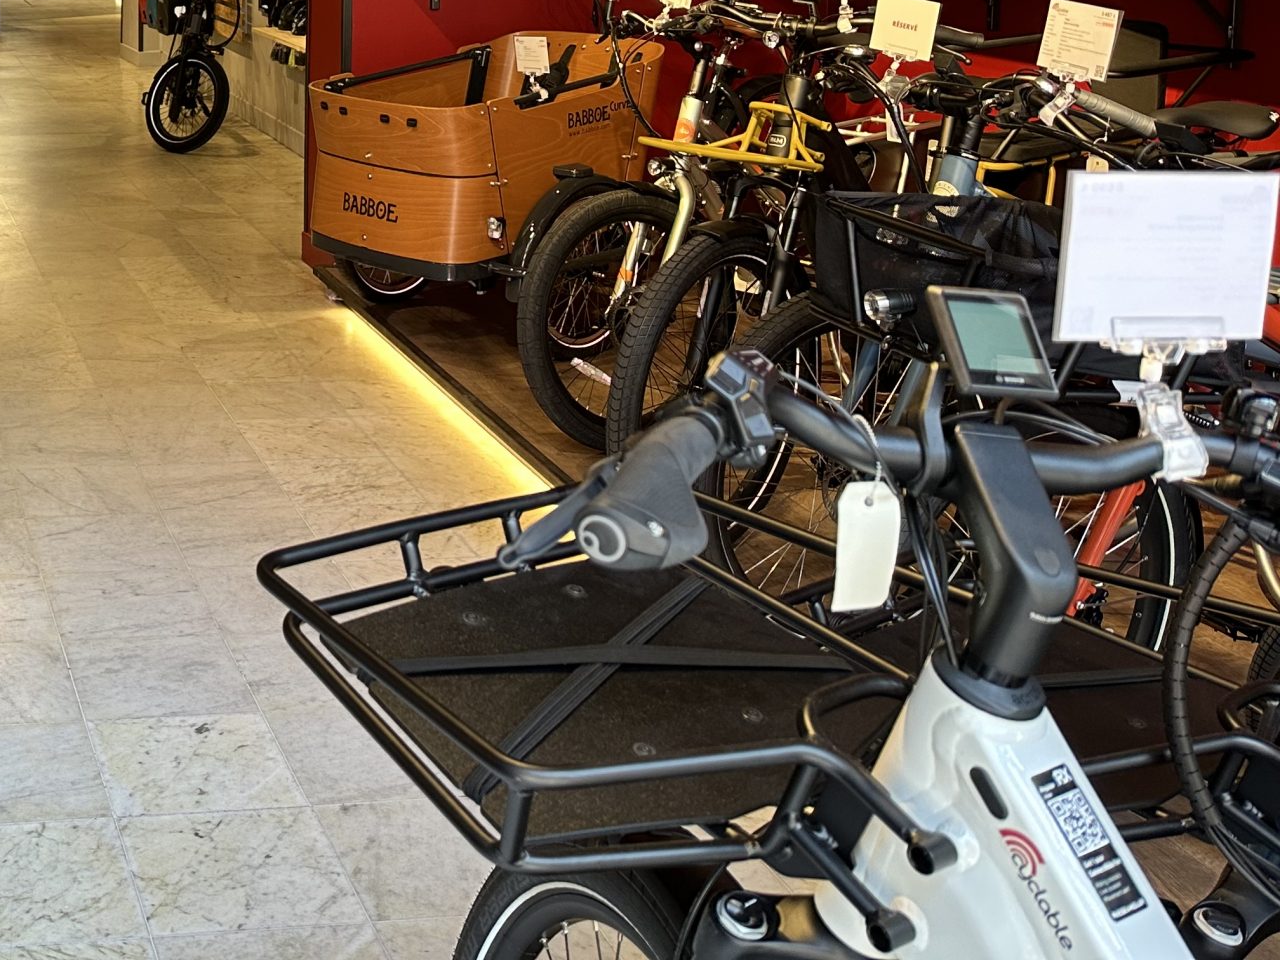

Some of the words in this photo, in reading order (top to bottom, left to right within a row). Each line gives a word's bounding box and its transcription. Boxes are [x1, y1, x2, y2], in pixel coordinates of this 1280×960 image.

[892, 20, 918, 32] RÉSERVÉ
[567, 105, 610, 129] BABBOE
[343, 191, 398, 223] BABBOE
[1010, 850, 1074, 951] cyclable
